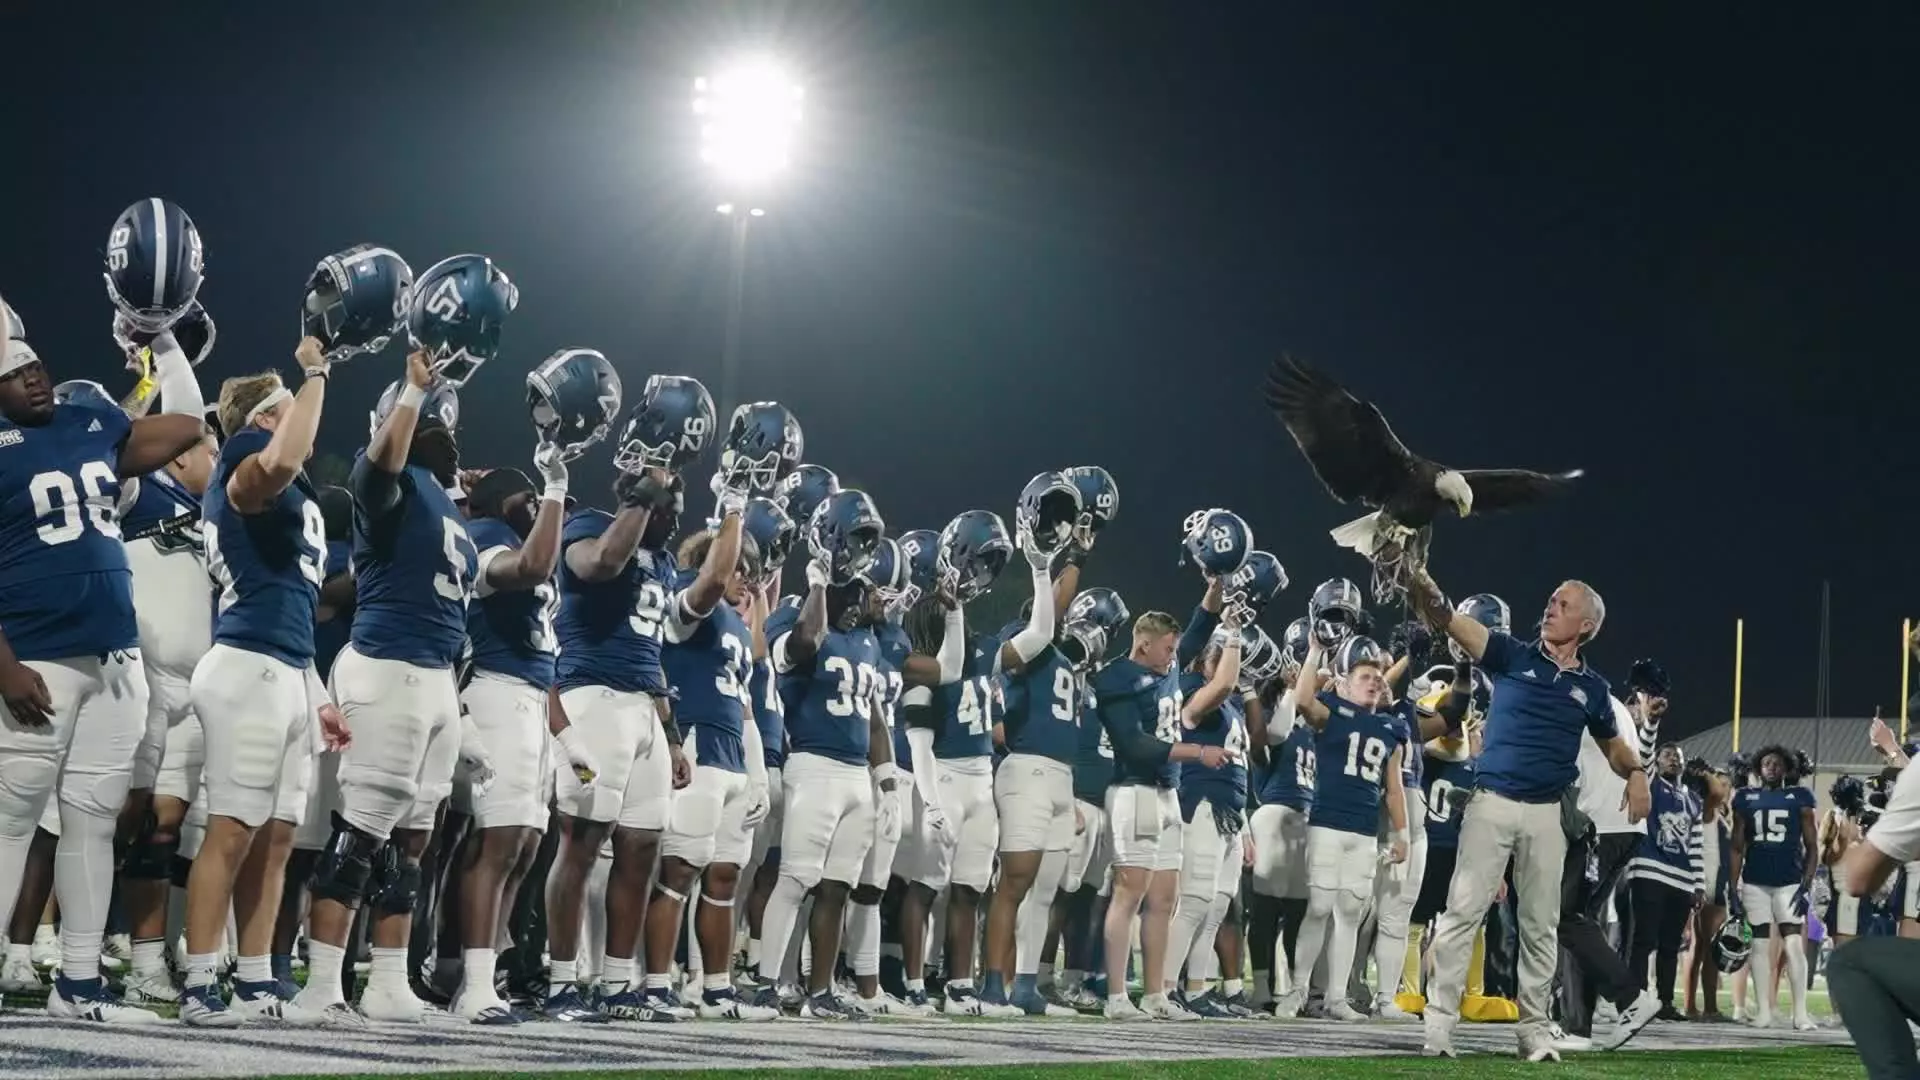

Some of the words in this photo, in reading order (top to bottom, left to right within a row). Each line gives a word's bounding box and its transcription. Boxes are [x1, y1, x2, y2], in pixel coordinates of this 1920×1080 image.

[425, 275, 464, 321] 57
[679, 416, 705, 451] 92
[29, 460, 124, 546] 96
[1095, 493, 1112, 521] 97
[299, 499, 329, 590] 9
[1211, 525, 1233, 554] 29
[1231, 564, 1256, 587] 40
[824, 655, 872, 721] 30
[1343, 731, 1387, 783] 19
[1753, 809, 1789, 842] 15
